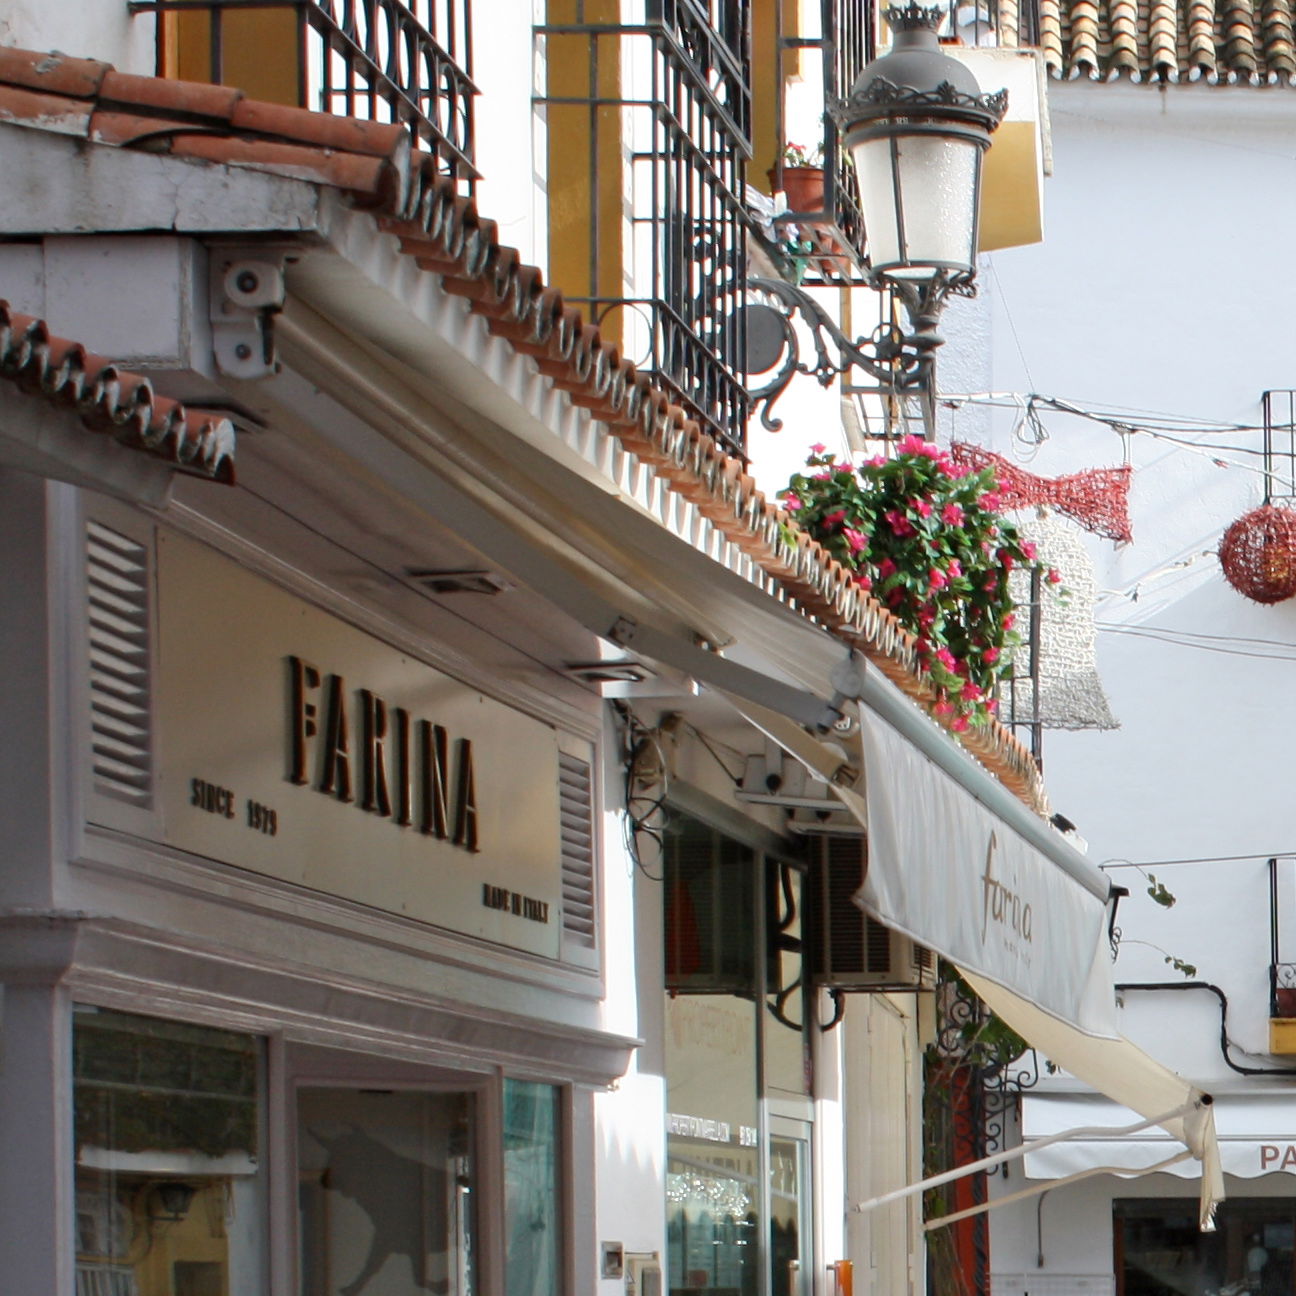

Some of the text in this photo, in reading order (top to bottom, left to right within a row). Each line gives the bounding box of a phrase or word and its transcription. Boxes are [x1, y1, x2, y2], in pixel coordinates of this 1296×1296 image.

[190, 777, 235, 820] SINCE
[287, 654, 481, 853] FARINA
[981, 829, 1032, 945] farina
